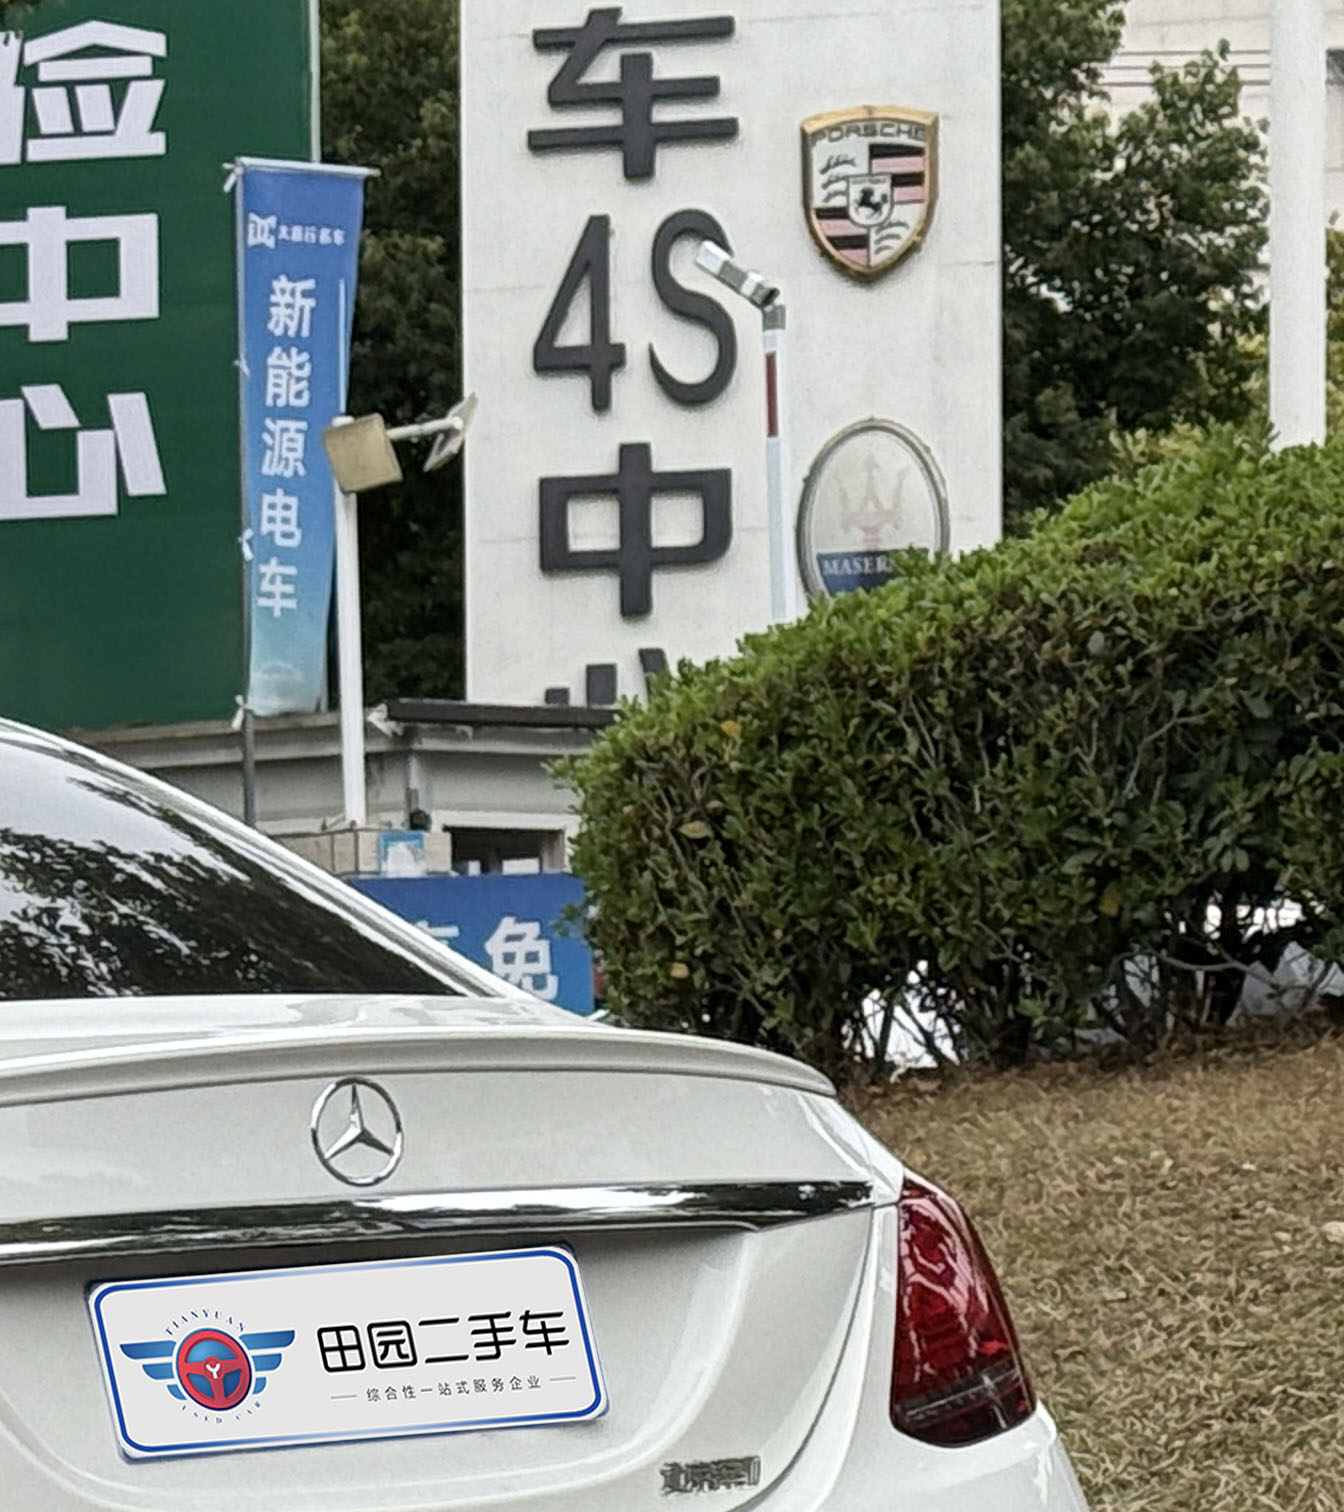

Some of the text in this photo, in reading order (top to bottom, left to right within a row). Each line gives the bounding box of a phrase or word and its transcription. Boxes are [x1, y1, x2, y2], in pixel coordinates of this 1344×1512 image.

[811, 122, 927, 147] PORSCHE
[255, 274, 317, 618] 新能源电车
[823, 555, 894, 576] MASER
